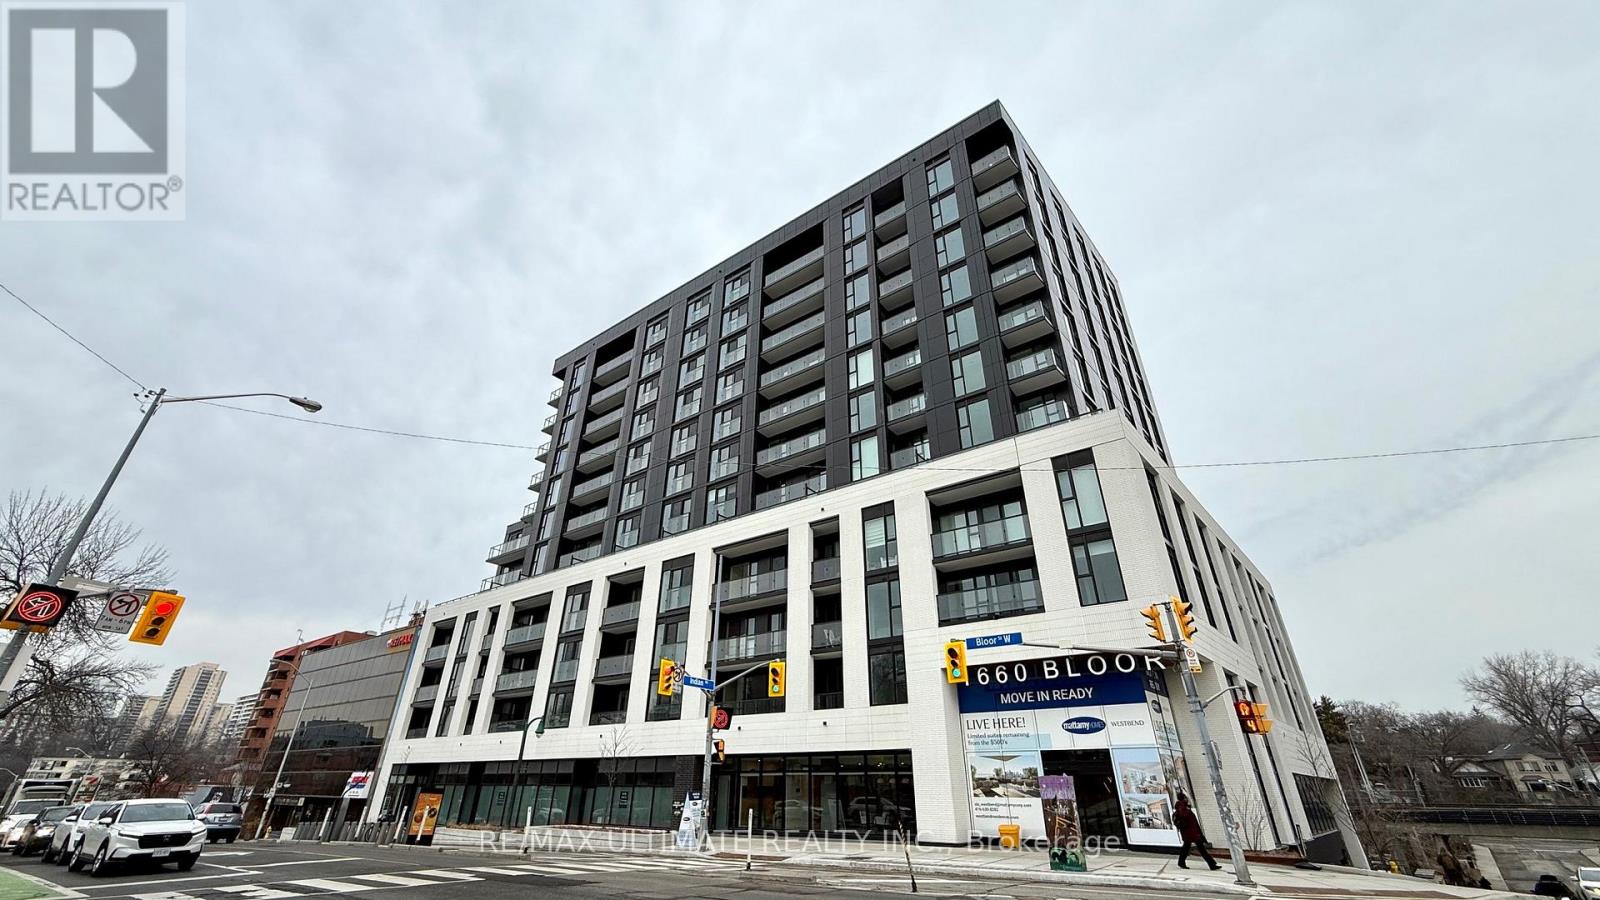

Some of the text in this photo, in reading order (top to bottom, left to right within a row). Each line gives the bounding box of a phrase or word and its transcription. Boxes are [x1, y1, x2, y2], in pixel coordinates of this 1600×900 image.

[976, 636, 997, 647] Bloor
[1003, 634, 1011, 643] W
[965, 663, 1028, 687] 660
[1000, 687, 1094, 705] MOVE IN READY
[966, 717, 1026, 730] LIVE HERE!
[1111, 719, 1145, 727] WESTBEND
